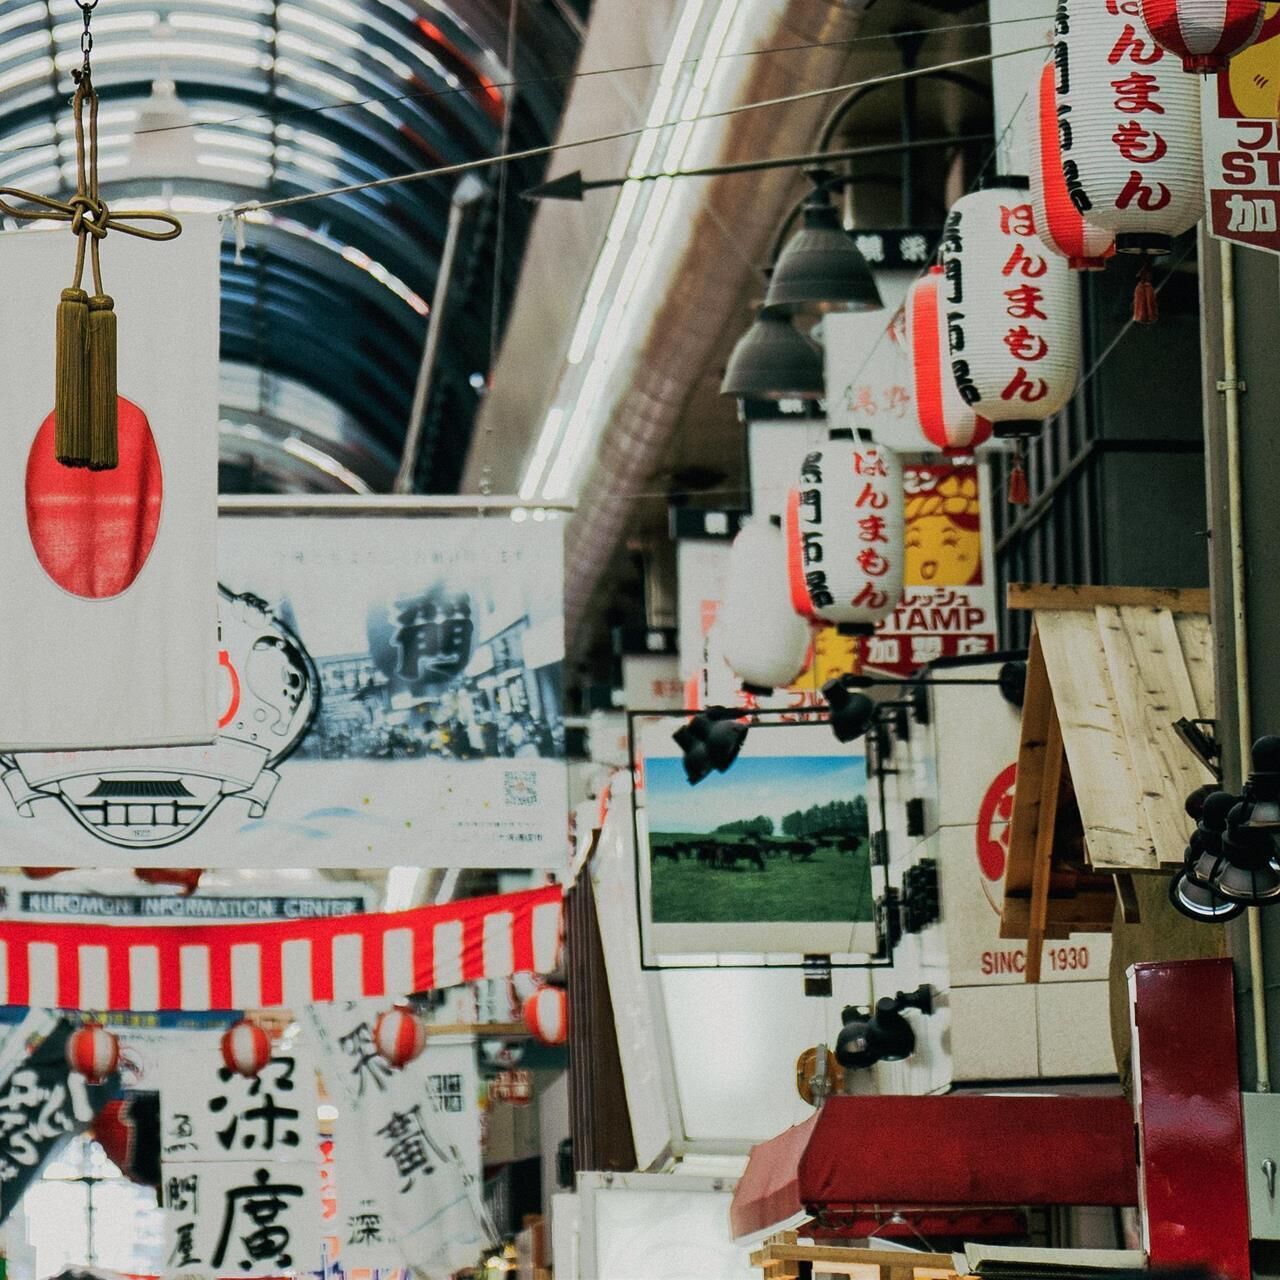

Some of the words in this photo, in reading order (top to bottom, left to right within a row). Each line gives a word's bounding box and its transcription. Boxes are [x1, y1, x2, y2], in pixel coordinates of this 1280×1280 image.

[1000, 203, 1050, 403] ほんまもん
[850, 448, 891, 610] ほんまもん
[981, 951, 1026, 974] SINC
[1049, 946, 1089, 970] 1930
